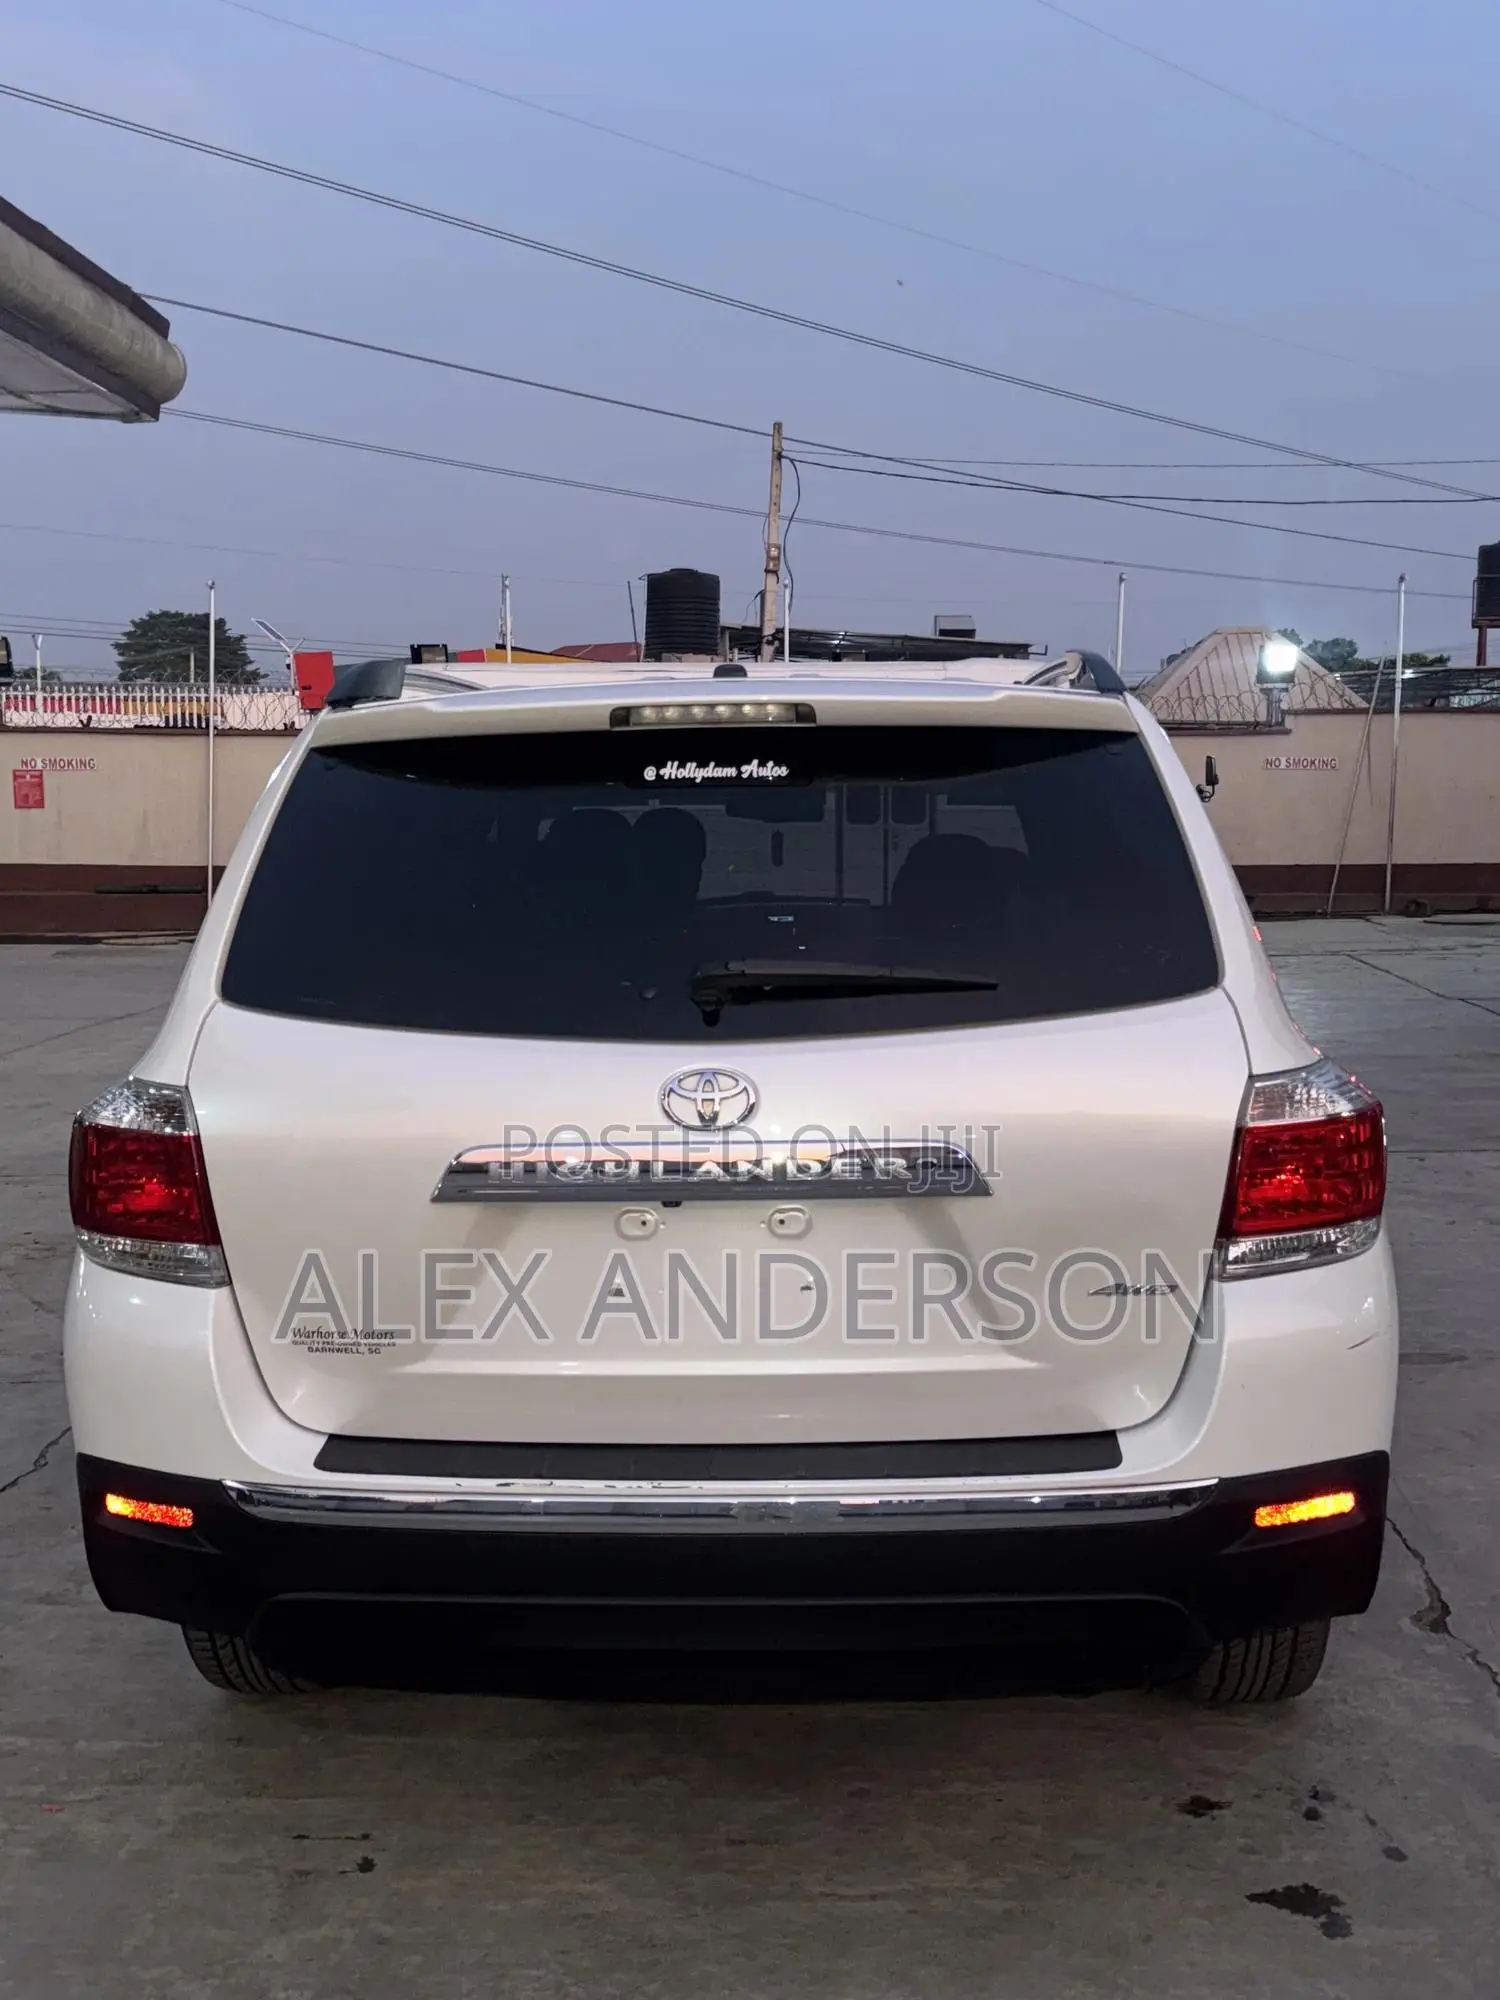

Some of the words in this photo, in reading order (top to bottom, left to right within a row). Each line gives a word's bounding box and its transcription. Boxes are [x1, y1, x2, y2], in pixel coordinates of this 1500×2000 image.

[20, 757, 38, 769] NO
[41, 758, 96, 770] SMOKING
[1265, 757, 1281, 769] NO
[1285, 757, 1337, 769] SMOKING
[659, 760, 737, 783] Hollydam
[740, 758, 789, 779] Autos
[351, 1328, 396, 1340] Motors
[367, 1347, 382, 1355] SC
